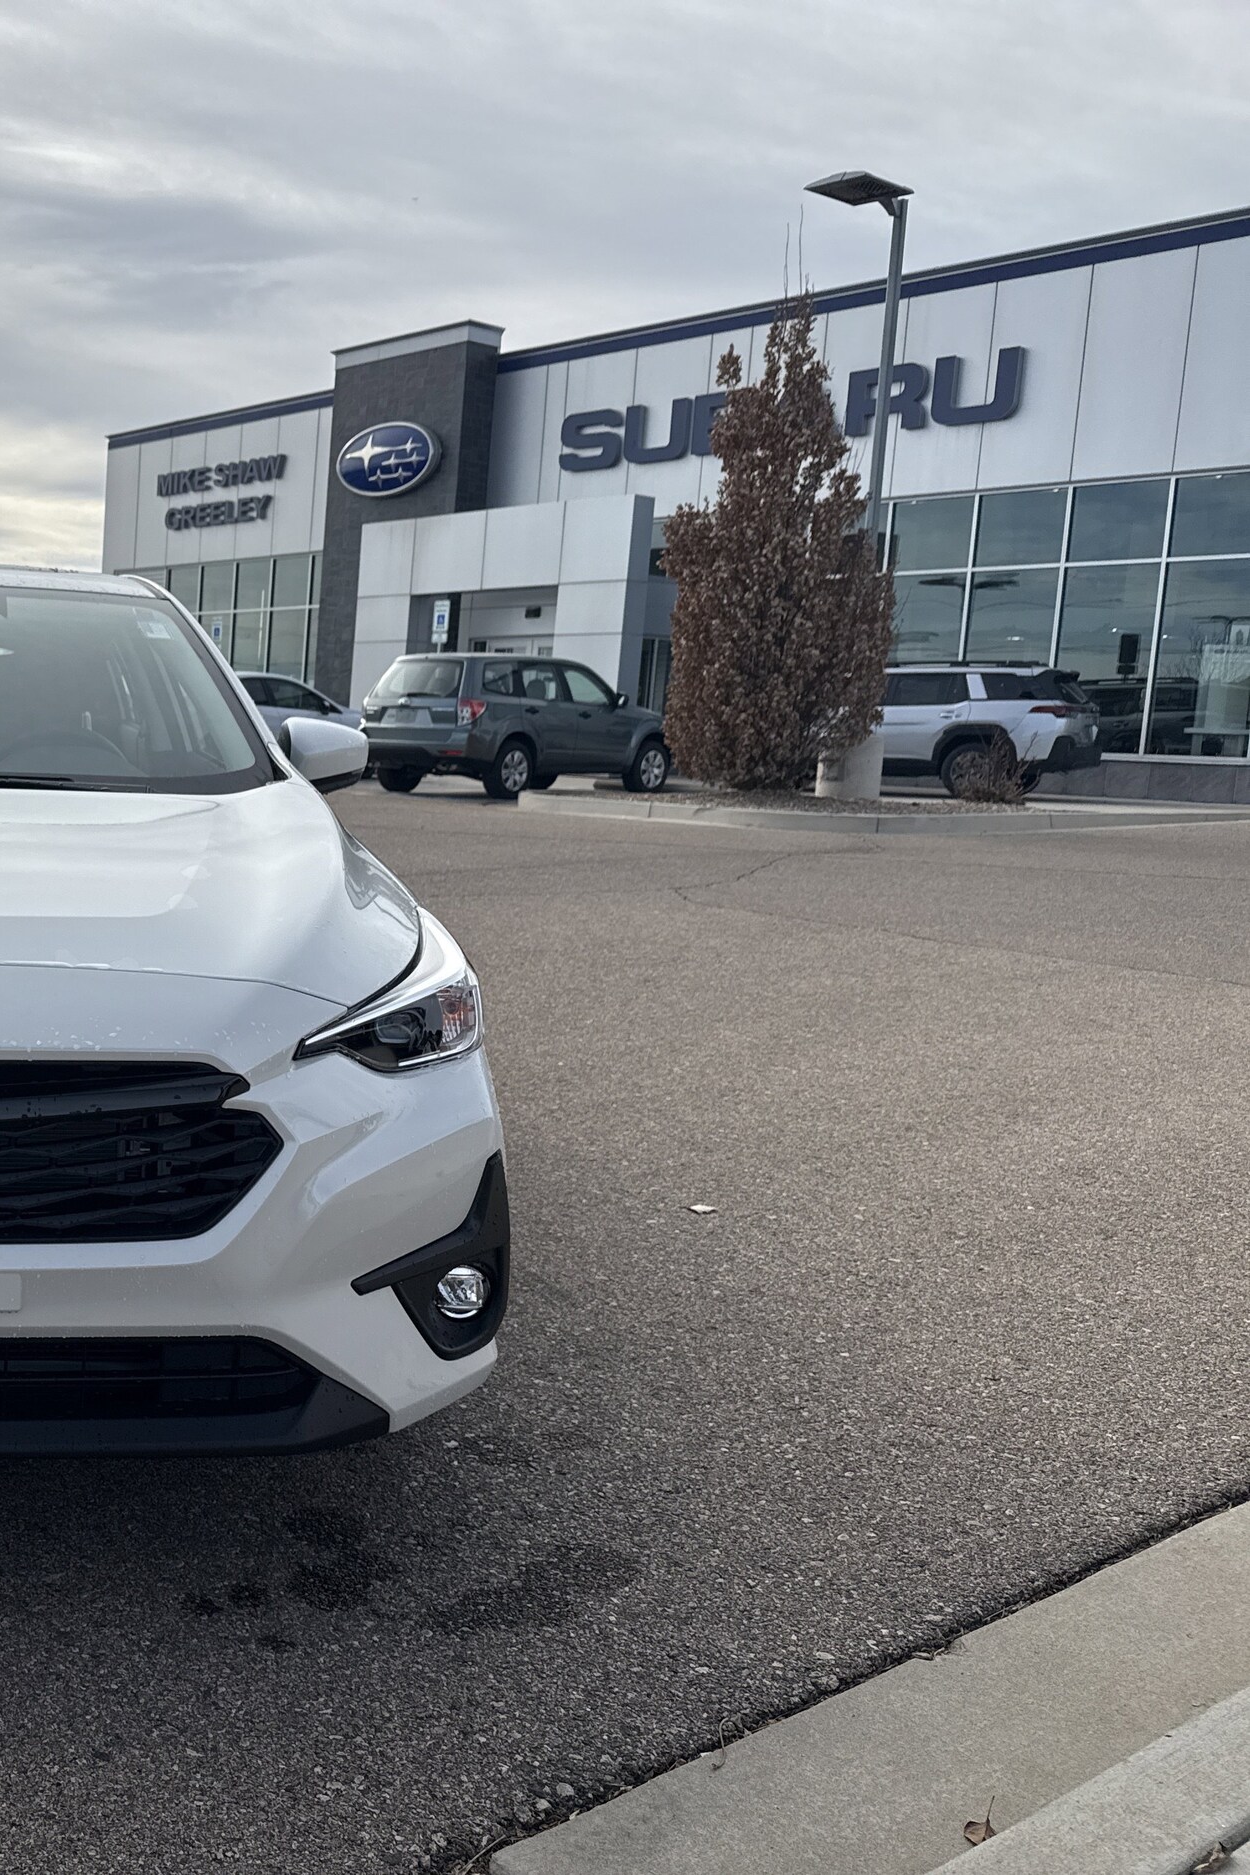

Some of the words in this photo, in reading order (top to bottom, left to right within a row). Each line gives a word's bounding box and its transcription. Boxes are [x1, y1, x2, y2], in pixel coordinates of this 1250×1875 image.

[559, 346, 1026, 472] SURU
[157, 466, 212, 497] MIKE
[213, 454, 288, 488] SHAW
[165, 494, 273, 531] GREELEY
